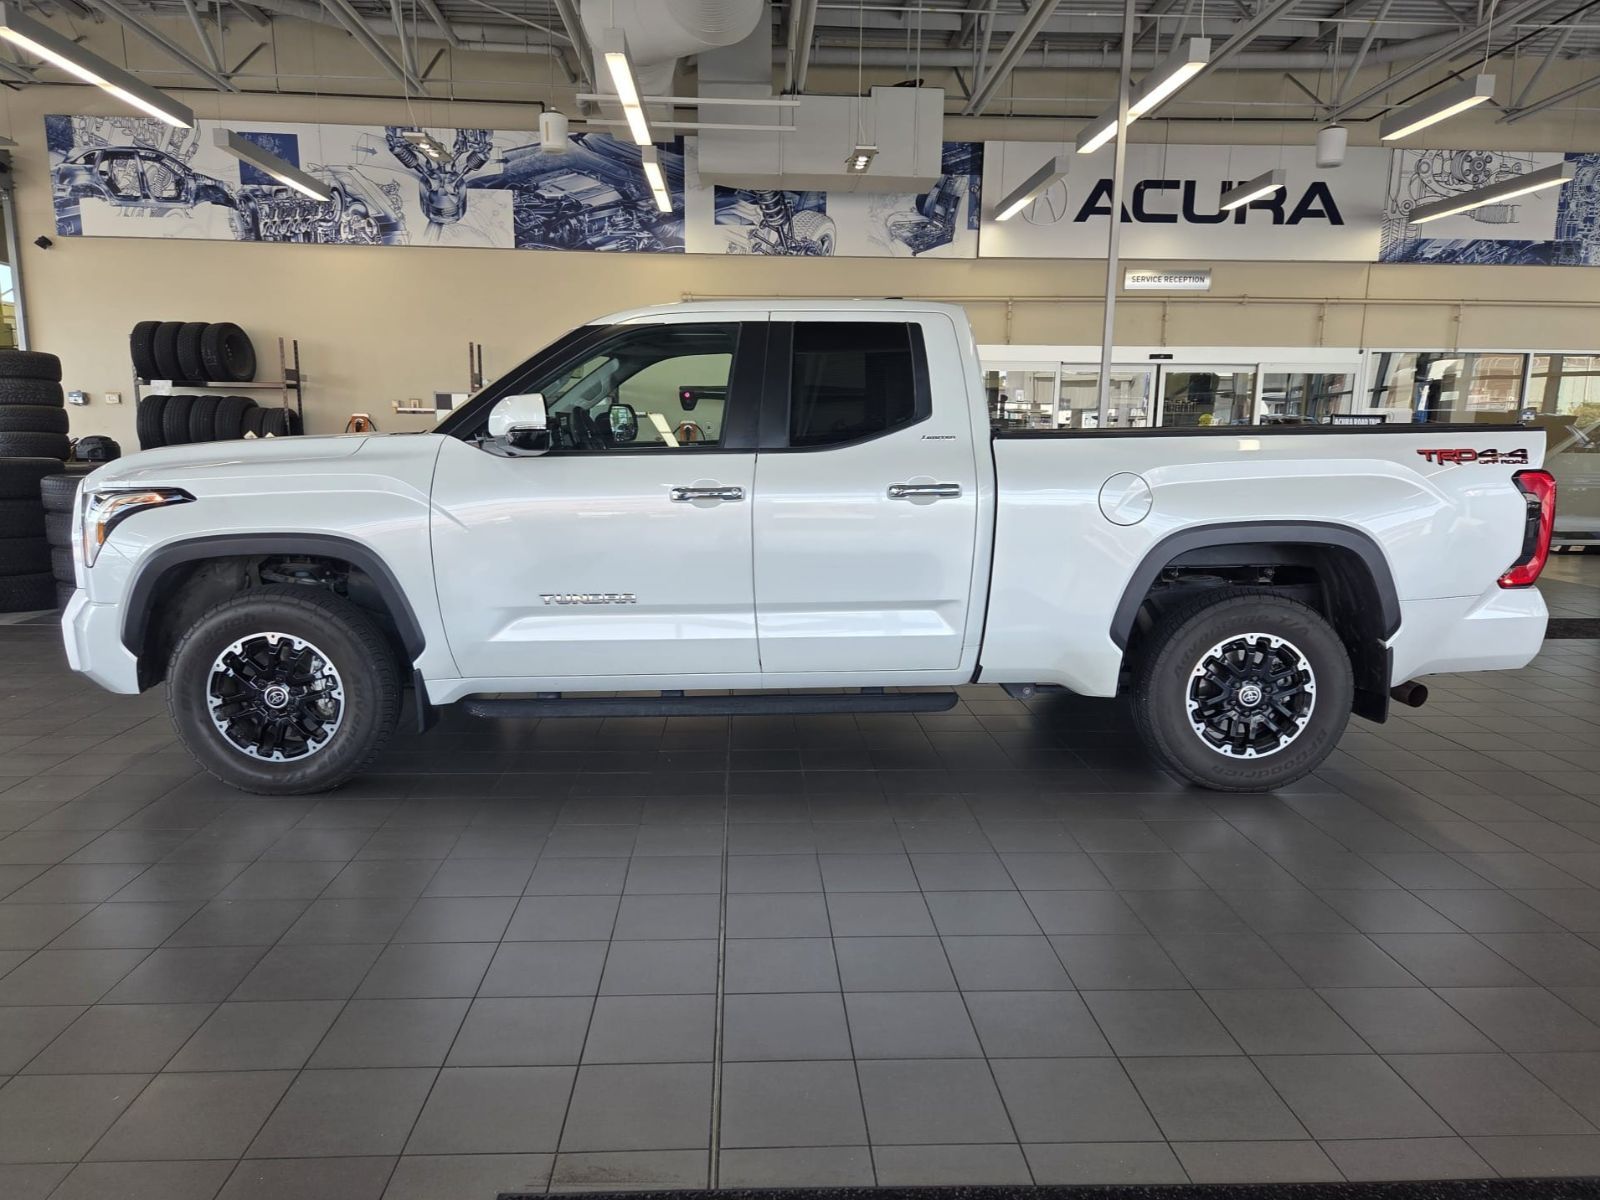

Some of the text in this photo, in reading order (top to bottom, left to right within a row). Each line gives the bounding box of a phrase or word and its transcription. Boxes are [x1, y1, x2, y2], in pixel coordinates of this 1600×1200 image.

[1073, 179, 1344, 225] ACURA
[1131, 275, 1206, 284] SERVICE RECEPTION
[1416, 448, 1478, 466] TRD
[539, 594, 637, 605] TUNDRA
